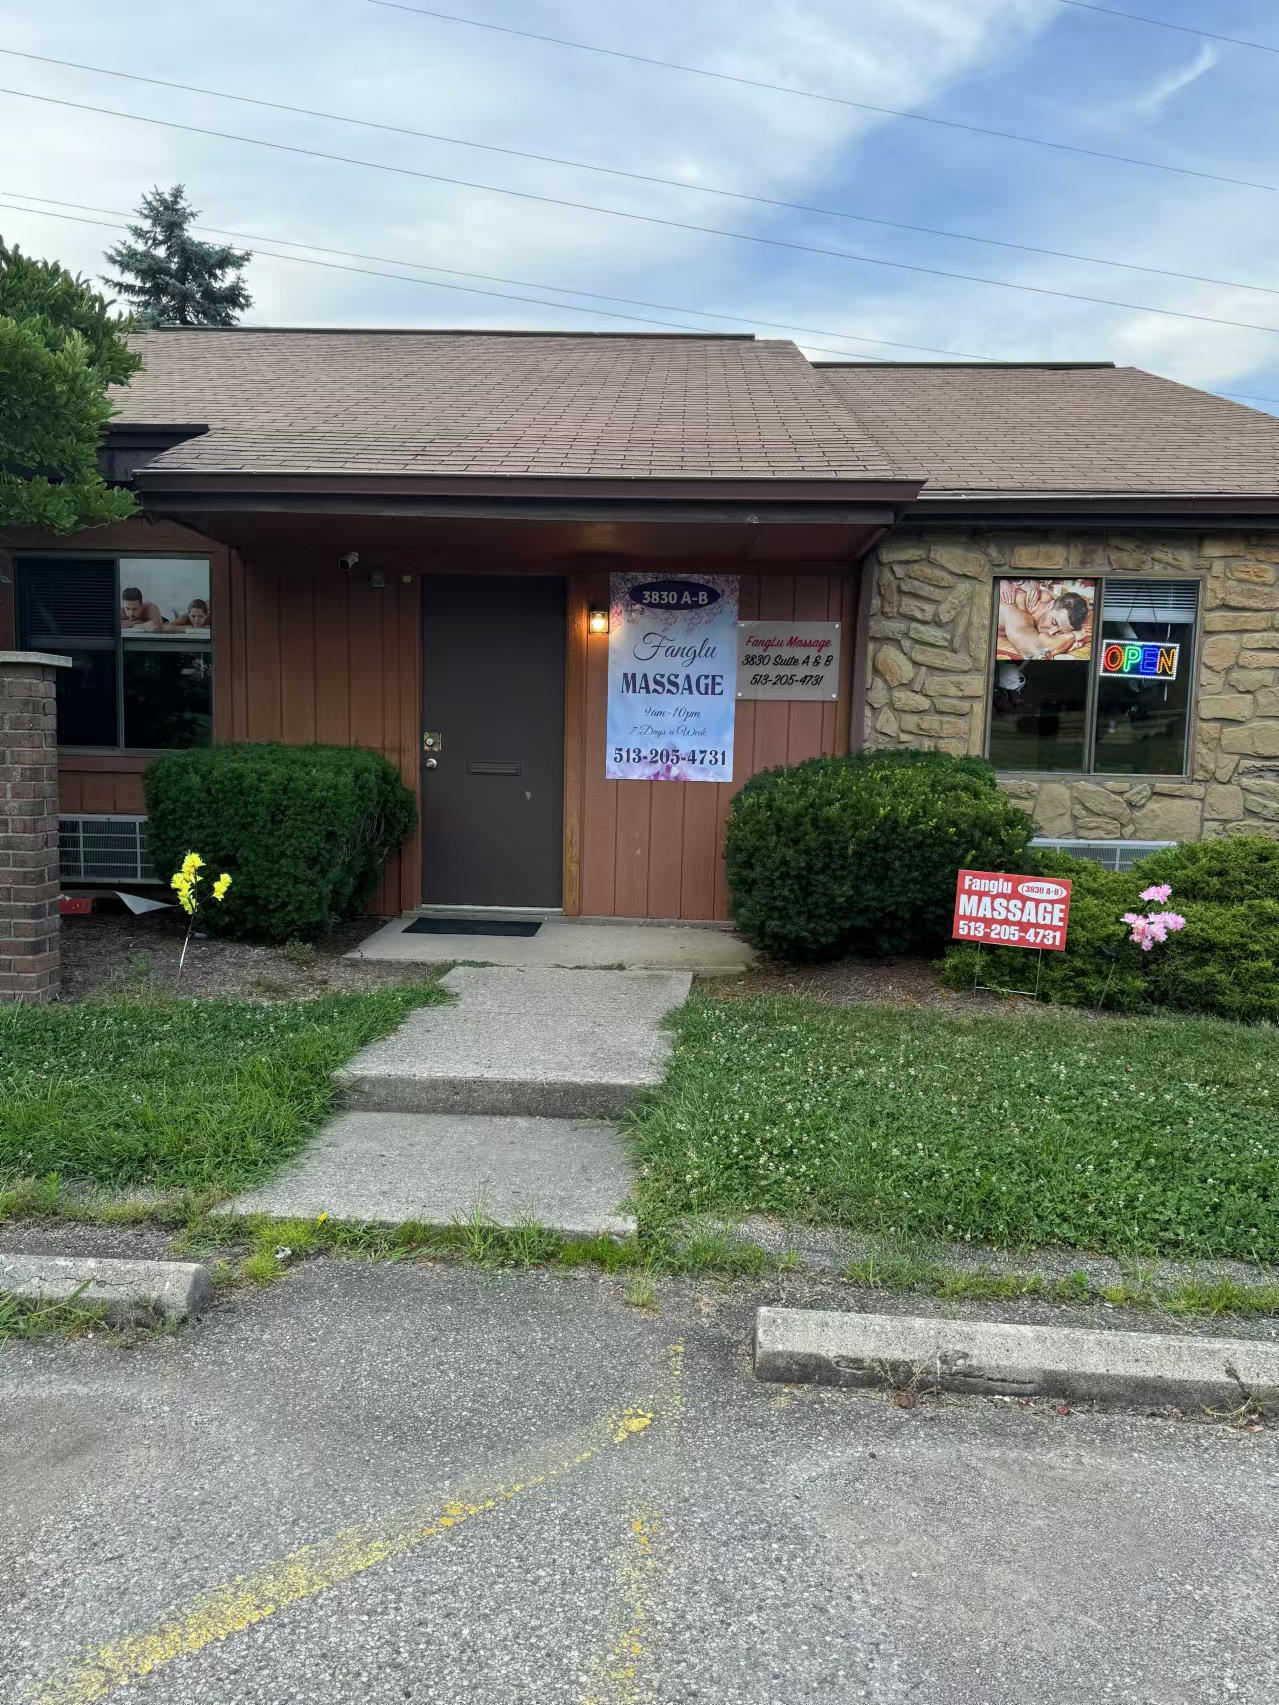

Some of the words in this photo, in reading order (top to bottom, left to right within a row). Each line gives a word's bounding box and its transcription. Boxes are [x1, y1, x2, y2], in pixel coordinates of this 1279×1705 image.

[642, 591, 678, 604] 3830
[680, 591, 708, 605] A-B
[632, 632, 718, 668] Fanglu
[786, 635, 832, 653] Massage
[741, 654, 771, 666] 3830
[772, 654, 800, 667] Suite
[801, 655, 811, 667] A
[812, 655, 822, 667] &
[824, 655, 834, 667] B
[1104, 645, 1177, 675] OPEN
[620, 672, 724, 696] MASSAGE
[750, 673, 824, 686] 513-205-4731
[629, 726, 638, 735] 7
[639, 724, 666, 738] Days
[676, 725, 707, 737] Week
[613, 748, 726, 766] 513-205-4731
[964, 875, 1012, 895] Fanglu
[1021, 884, 1044, 894] (3830
[958, 894, 1065, 926] MASSAGE
[958, 920, 1061, 945] 513-205-4731
